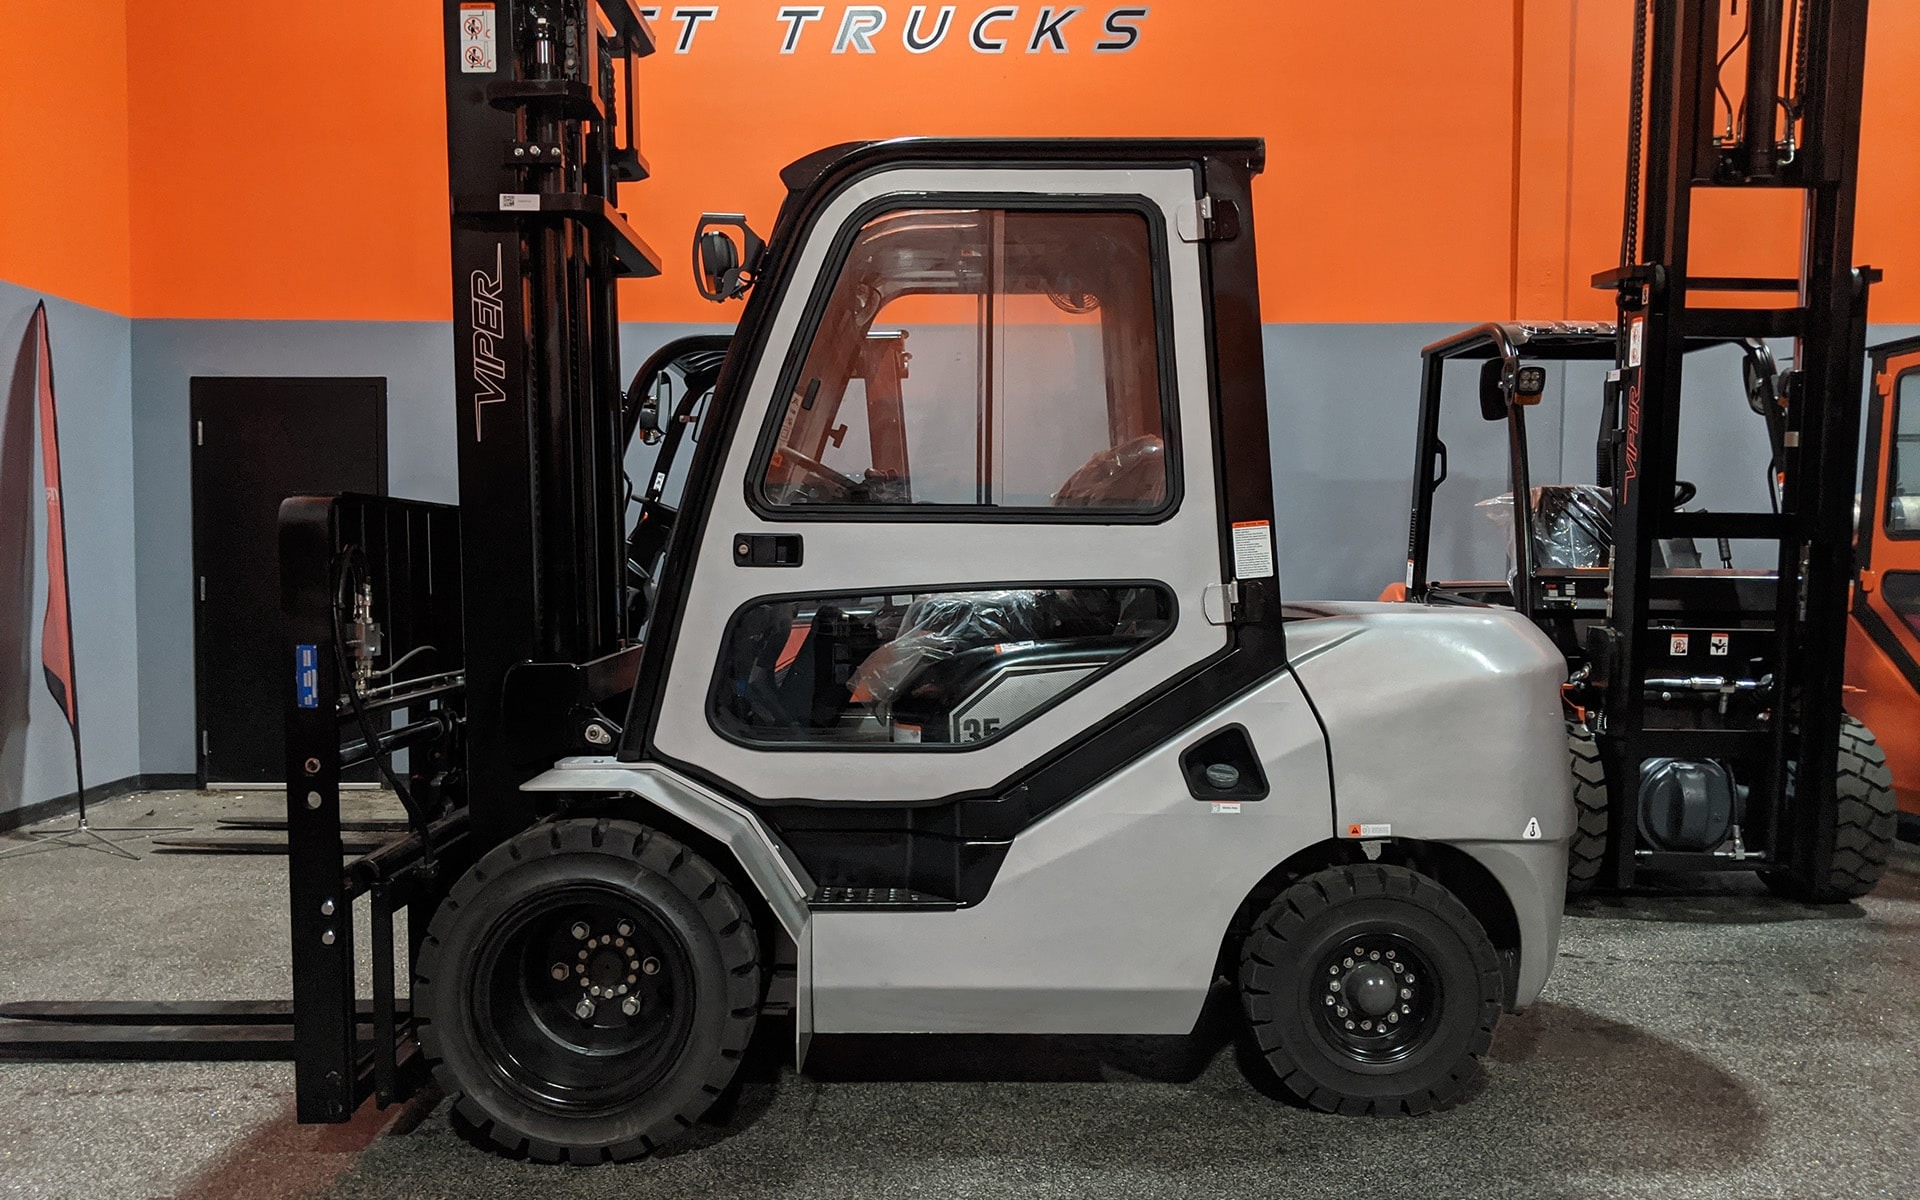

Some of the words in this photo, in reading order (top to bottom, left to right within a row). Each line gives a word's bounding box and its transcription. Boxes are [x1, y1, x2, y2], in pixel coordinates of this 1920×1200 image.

[776, 6, 1150, 54] TRUCKS
[471, 243, 506, 442] VIPER
[1624, 367, 1641, 505] VIPER
